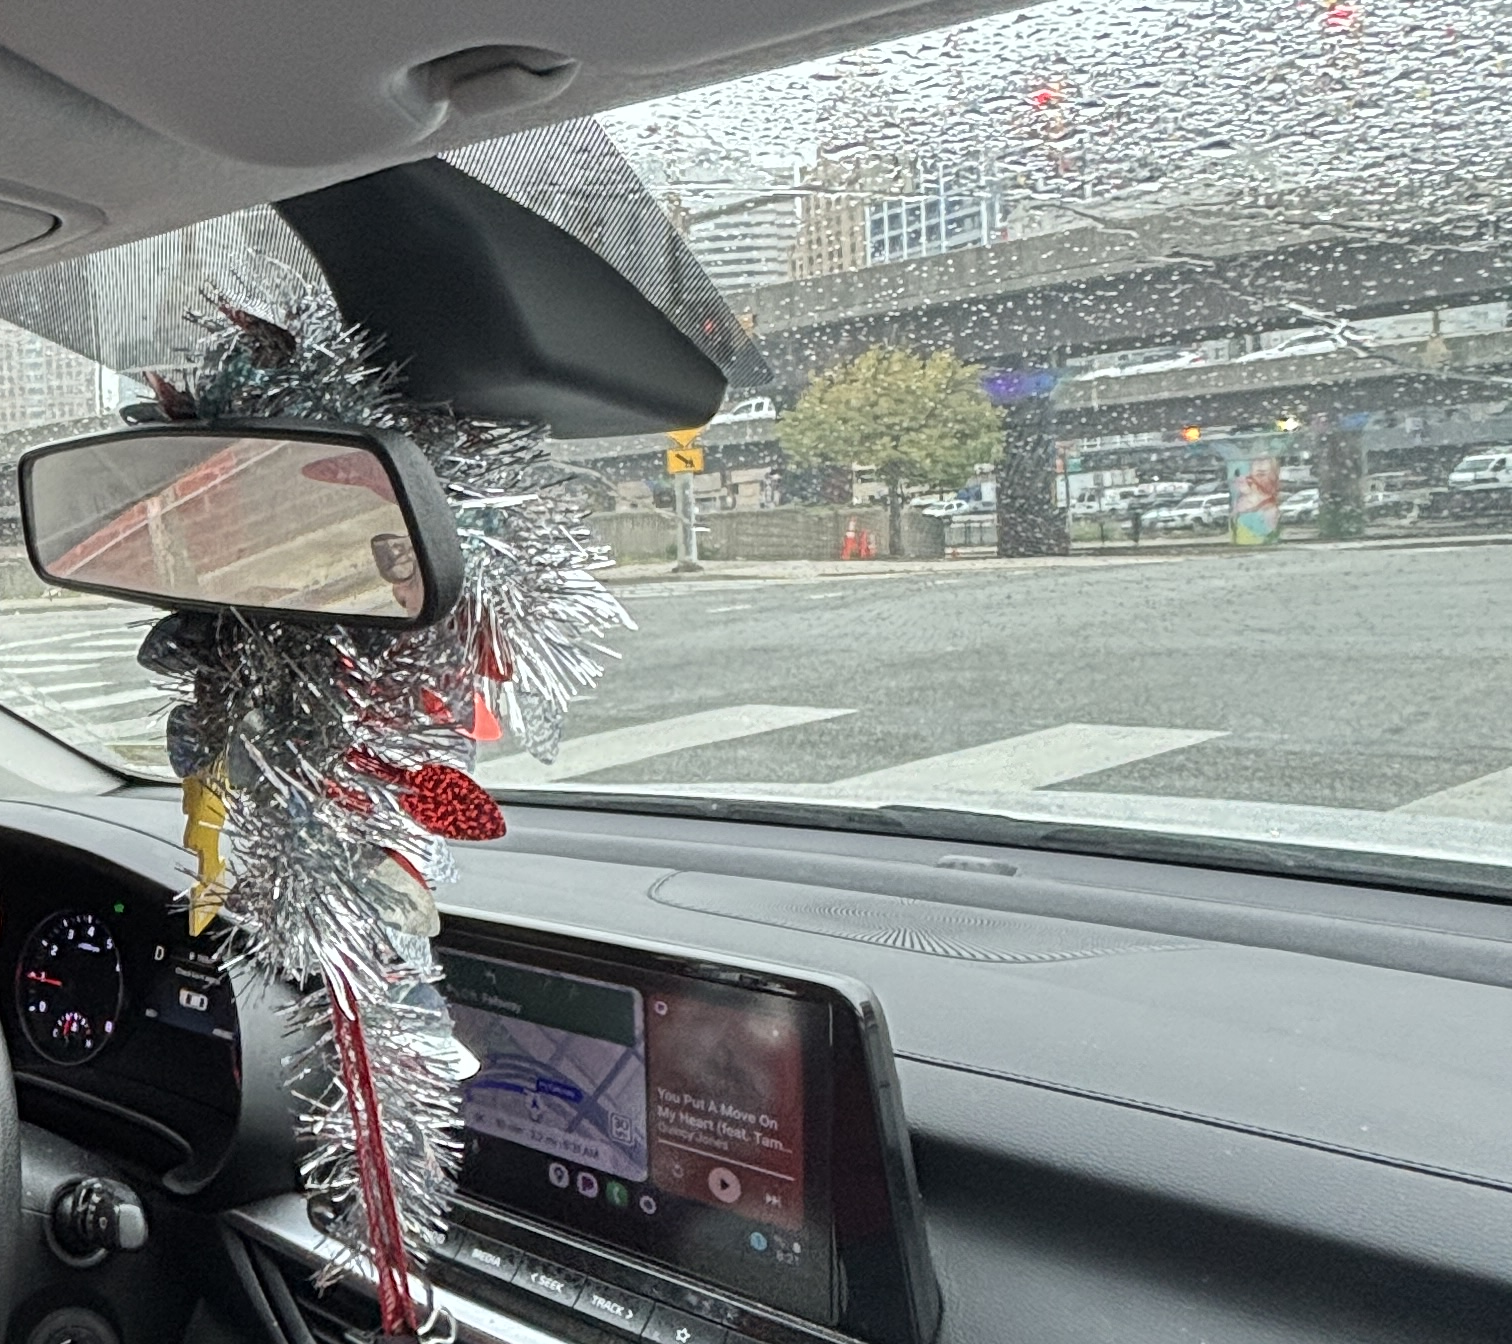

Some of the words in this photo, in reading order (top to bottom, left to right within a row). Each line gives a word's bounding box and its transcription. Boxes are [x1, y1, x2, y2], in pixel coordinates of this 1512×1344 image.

[67, 928, 75, 940] 3
[87, 925, 95, 937] 4
[50, 944, 59, 956] 2
[106, 937, 113, 950] 5
[154, 945, 164, 961] D
[657, 1087, 682, 1107] You
[683, 1093, 706, 1112] Put
[708, 1100, 718, 1114] A
[720, 1103, 757, 1126] Move
[759, 1113, 779, 1131] On
[657, 1105, 677, 1124] My
[679, 1111, 715, 1132] Heart
[471, 1248, 502, 1269] MEDIA
[539, 1271, 565, 1293] SEEK
[591, 1294, 624, 1318] TRACK
